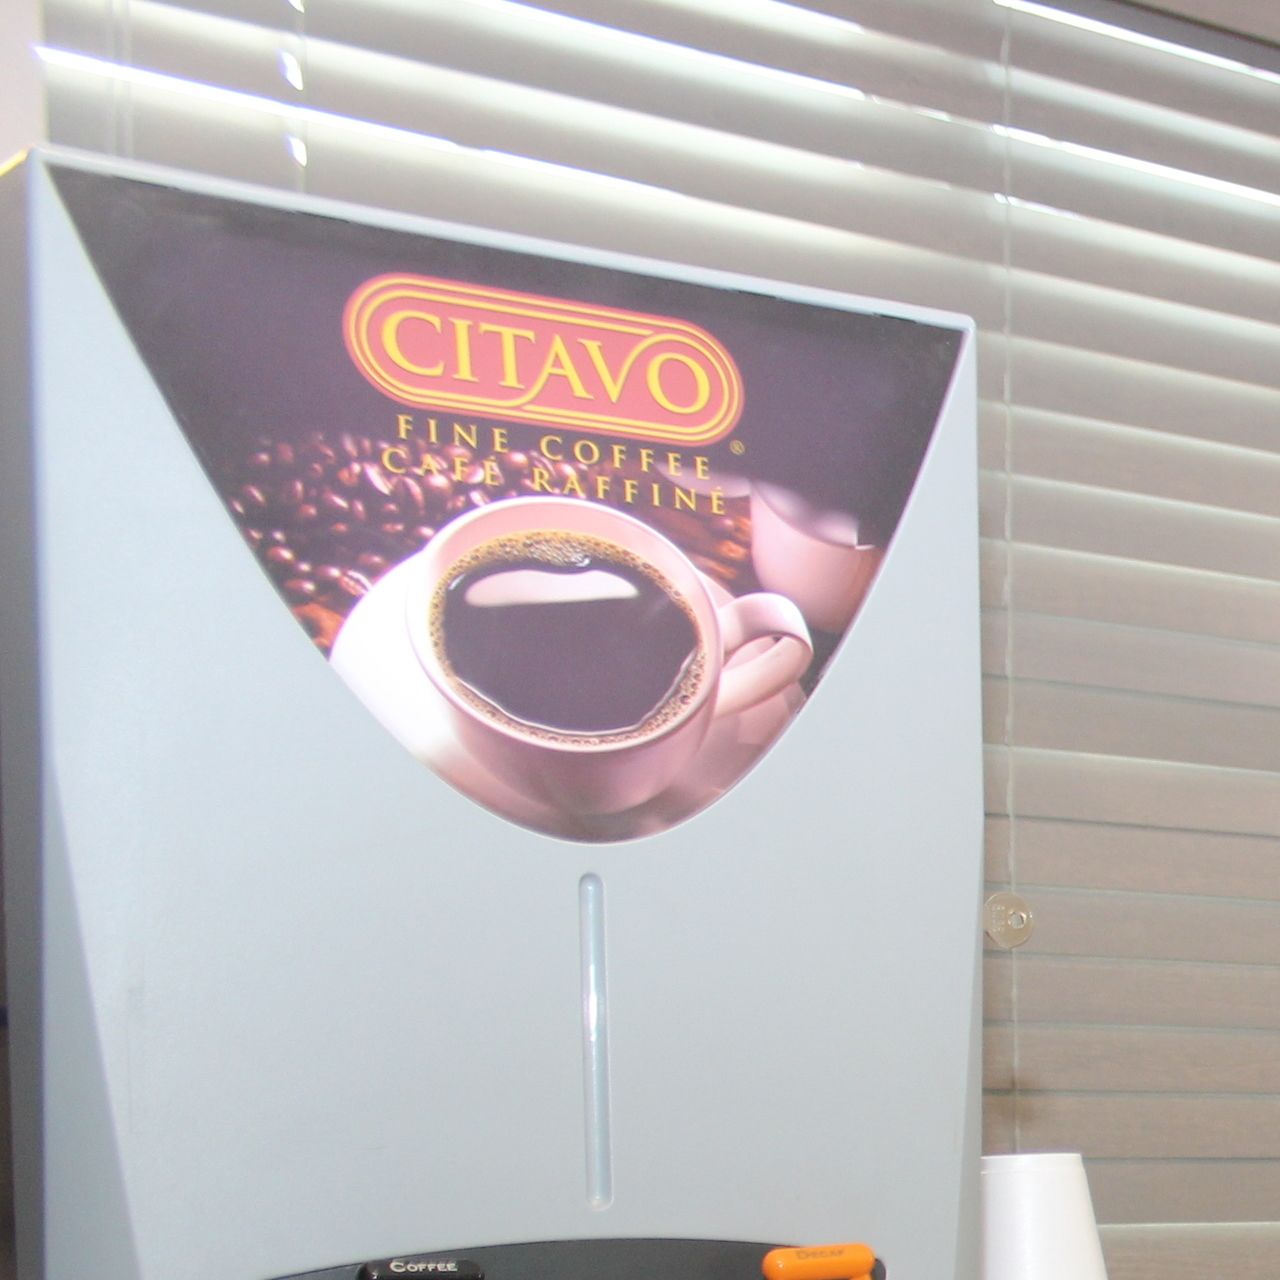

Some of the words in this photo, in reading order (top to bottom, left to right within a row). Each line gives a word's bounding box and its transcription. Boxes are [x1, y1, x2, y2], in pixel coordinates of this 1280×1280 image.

[381, 309, 711, 416] CITAVO
[397, 414, 509, 453] FINE
[540, 434, 711, 481] COFFEE
[381, 449, 501, 487] CAFÉ
[532, 466, 727, 516] RAFFINÉ
